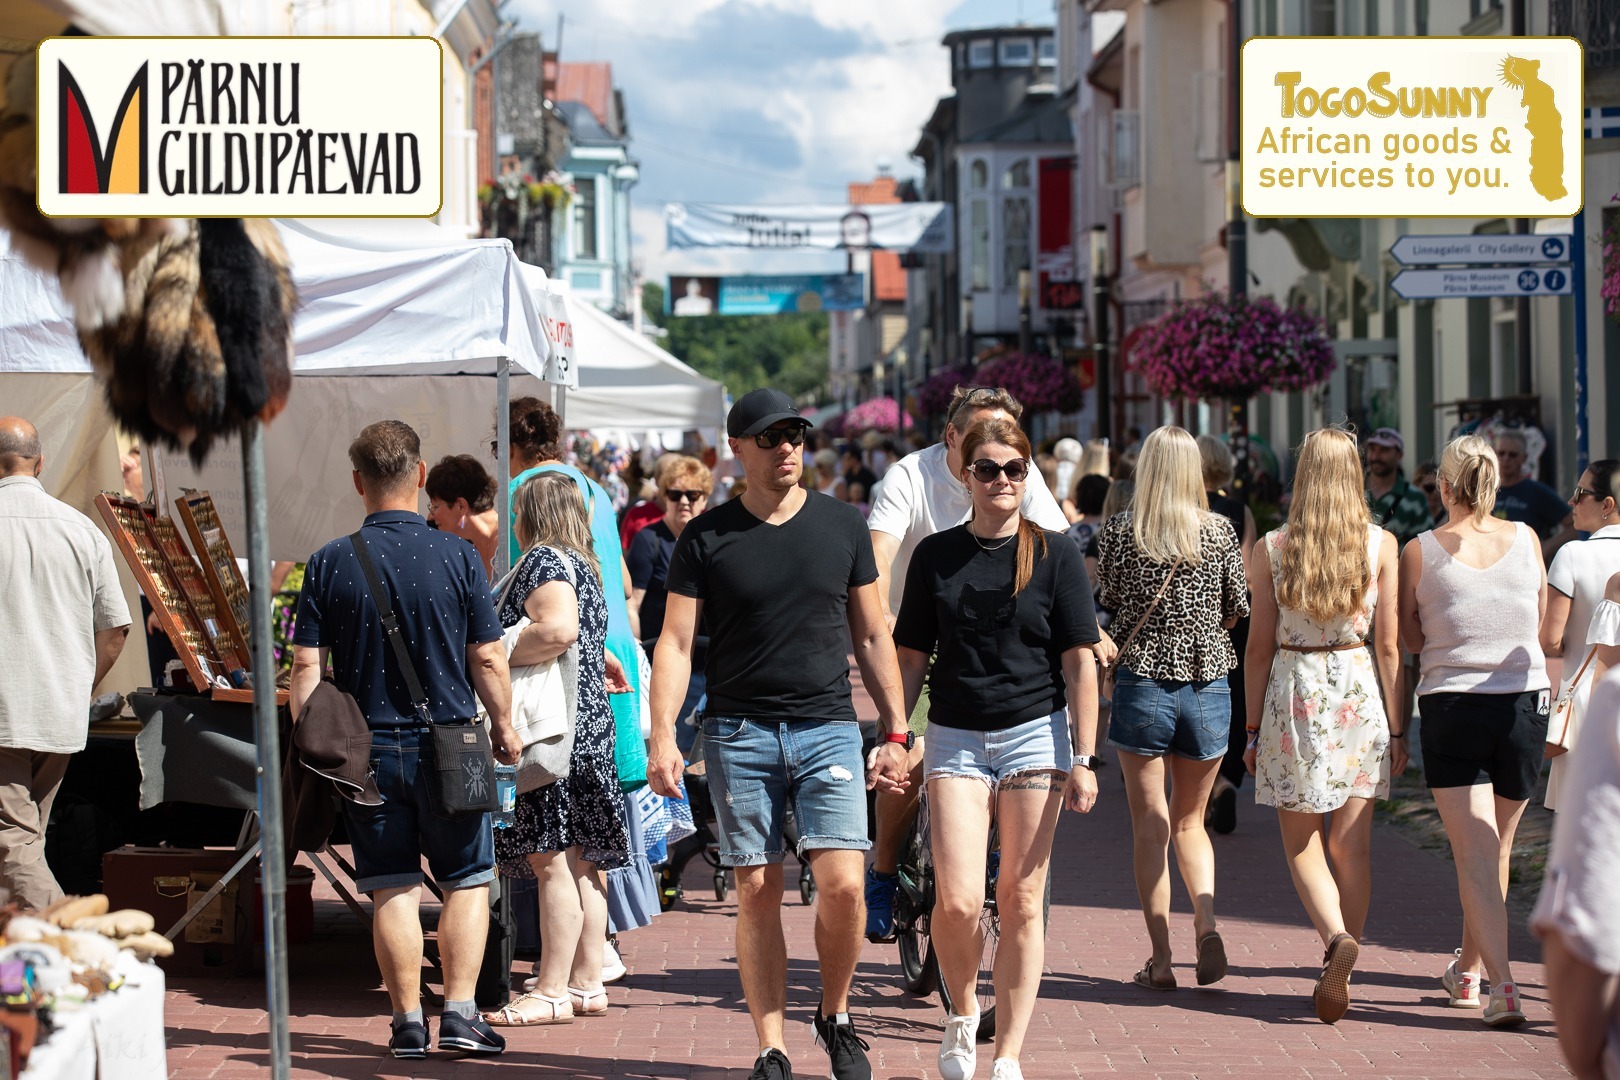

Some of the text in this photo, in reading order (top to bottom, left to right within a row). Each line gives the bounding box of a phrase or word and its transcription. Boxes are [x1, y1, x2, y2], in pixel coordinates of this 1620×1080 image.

[1412, 241, 1535, 257] Linnagalerii City Gallery
[1443, 273, 1467, 283] Pärnu
[1443, 283, 1505, 293] Pärnu Museum
